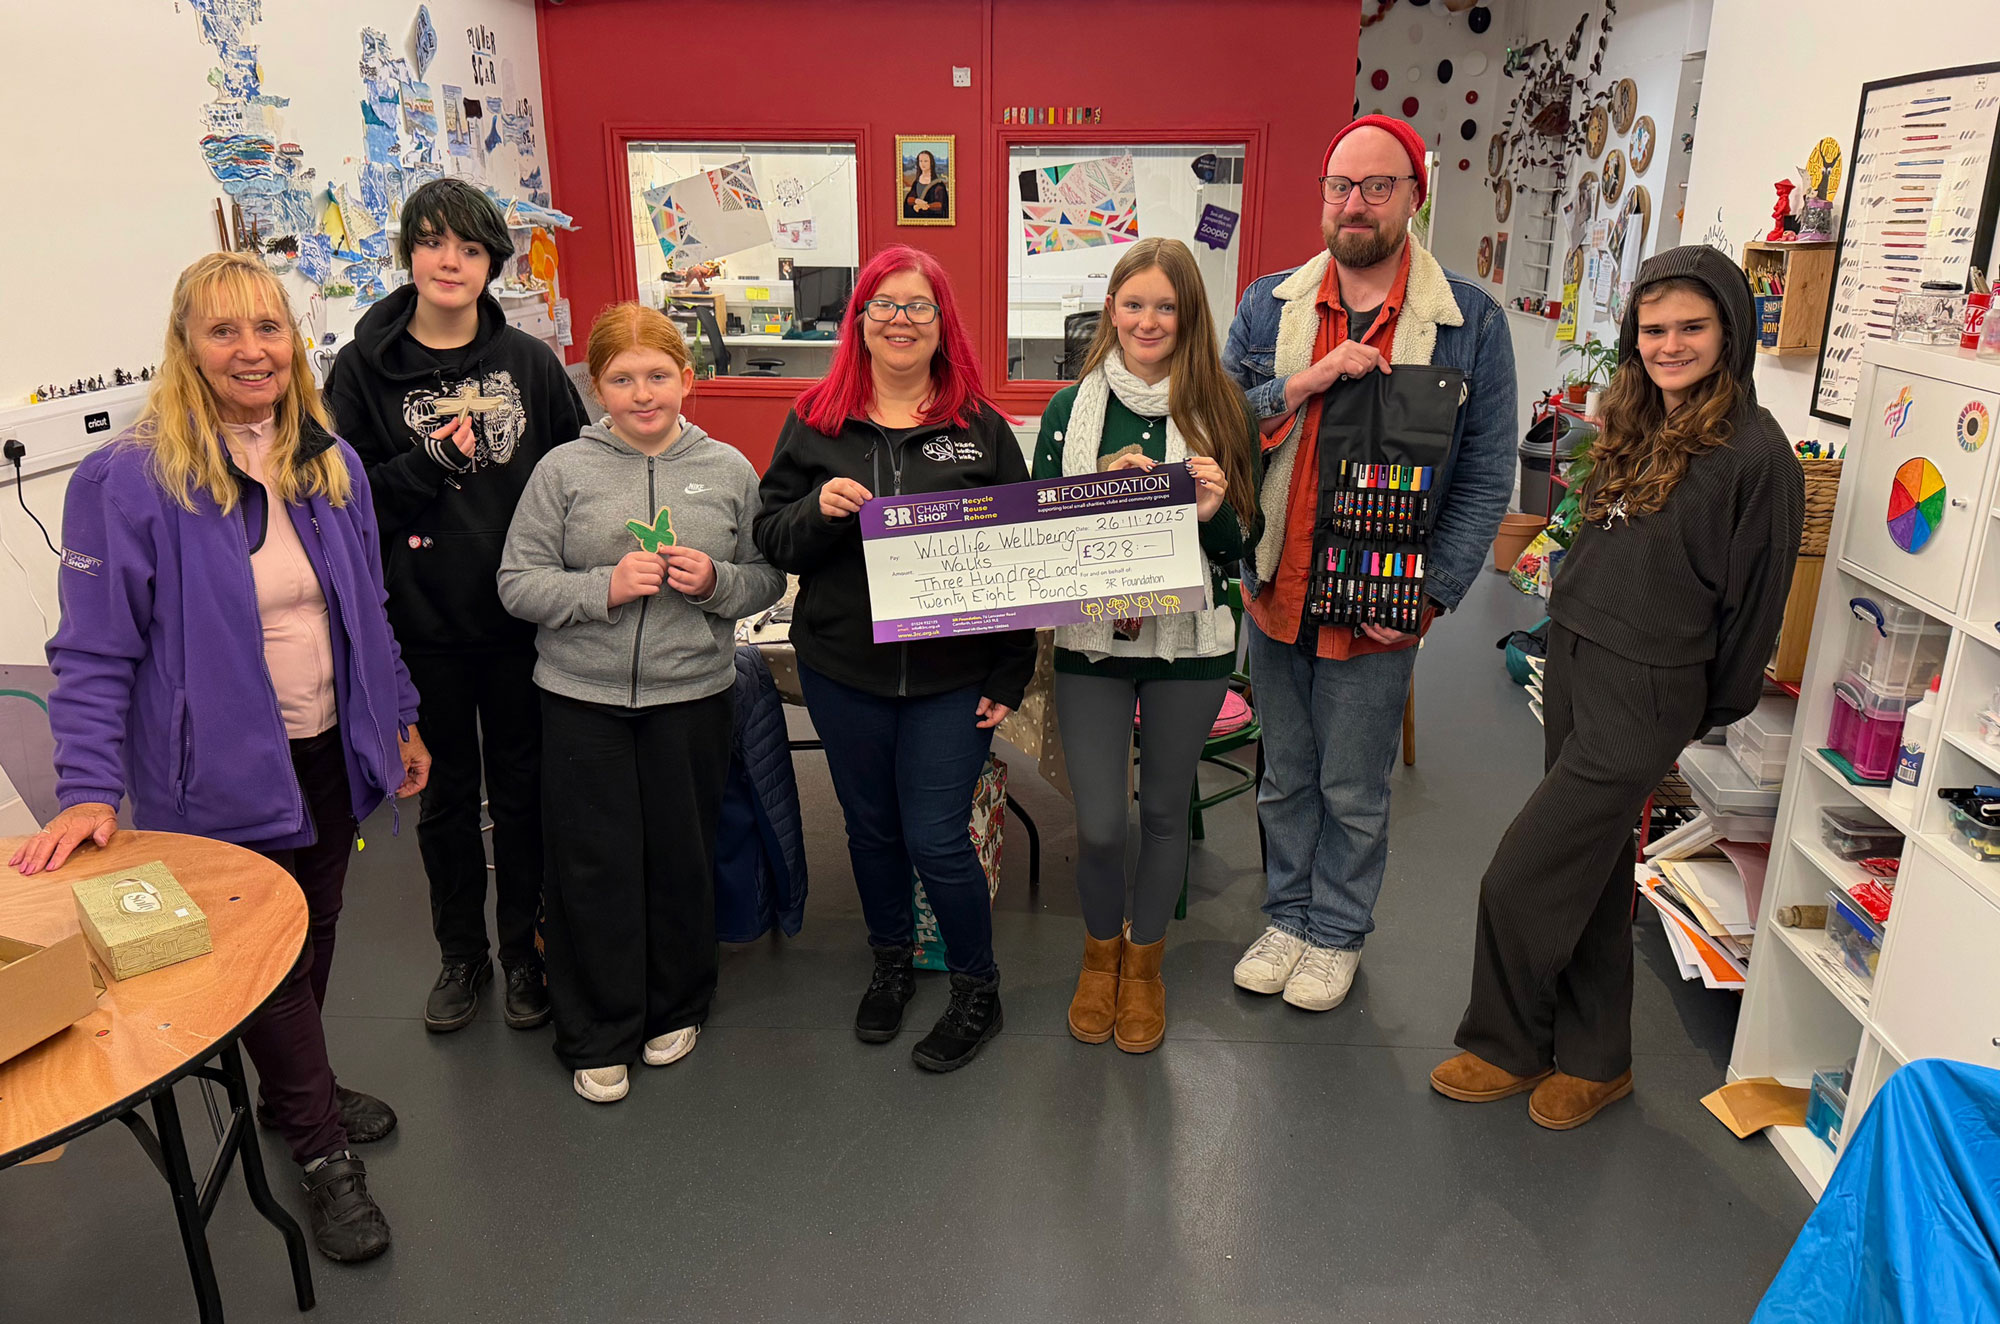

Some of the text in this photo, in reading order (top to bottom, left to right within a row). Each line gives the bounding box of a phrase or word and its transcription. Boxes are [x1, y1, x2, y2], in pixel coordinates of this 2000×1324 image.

[471, 54, 496, 86] SCAR
[1200, 223, 1229, 239] Zoopla
[88, 417, 108, 429] cricut
[1037, 475, 1170, 503] 3R FOUNDATION
[962, 495, 994, 505] Recycle
[884, 502, 960, 527] 3R CHARITY SHOP
[963, 505, 988, 513] Reuse
[964, 513, 998, 521] Rehome
[914, 527, 1077, 560] Wildlife Wellbeing
[68, 559, 90, 569] SHOP
[70, 553, 101, 567] CHARITY
[941, 556, 992, 572] Walks
[915, 560, 1078, 592] Three Hundred and
[1108, 567, 1124, 575] behalf
[1121, 574, 1165, 587] Foundation
[910, 579, 1088, 614] Twenty Eight Pounds
